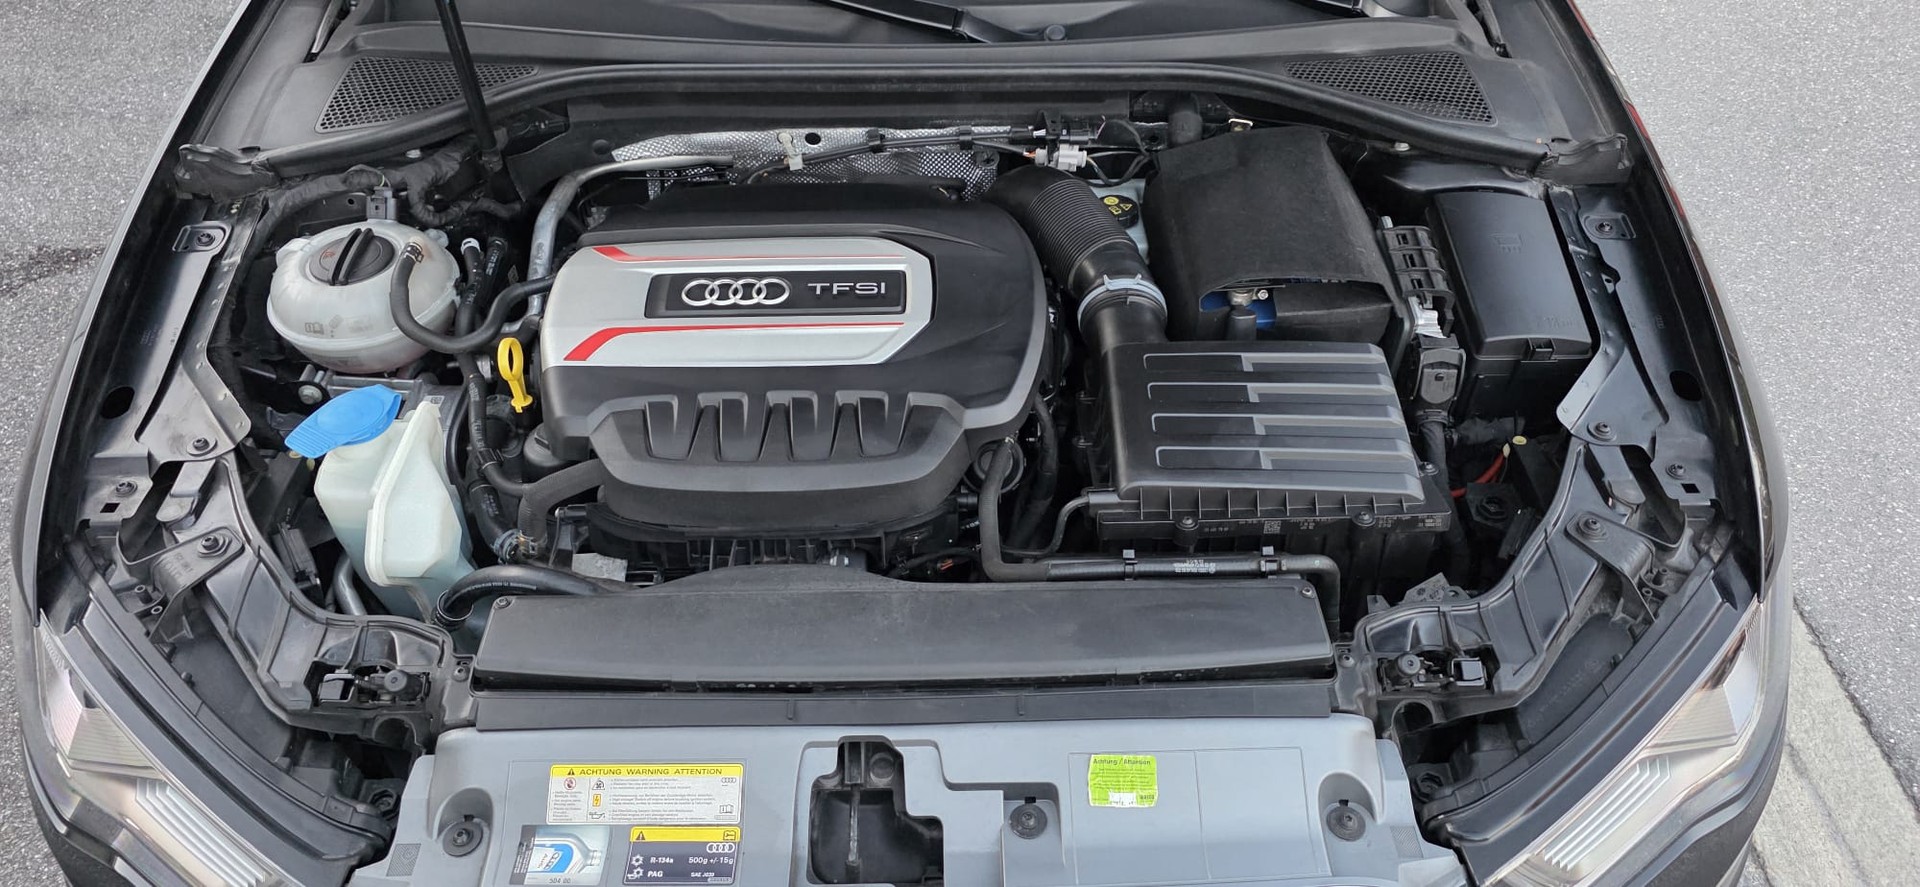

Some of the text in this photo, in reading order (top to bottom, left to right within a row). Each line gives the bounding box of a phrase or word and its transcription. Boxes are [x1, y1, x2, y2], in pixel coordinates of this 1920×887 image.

[807, 282, 886, 295] TFSI
[1093, 758, 1118, 766] Achtung
[579, 768, 622, 776] ACHTUNG
[626, 768, 670, 776] WARNING
[688, 856, 708, 865] 500g
